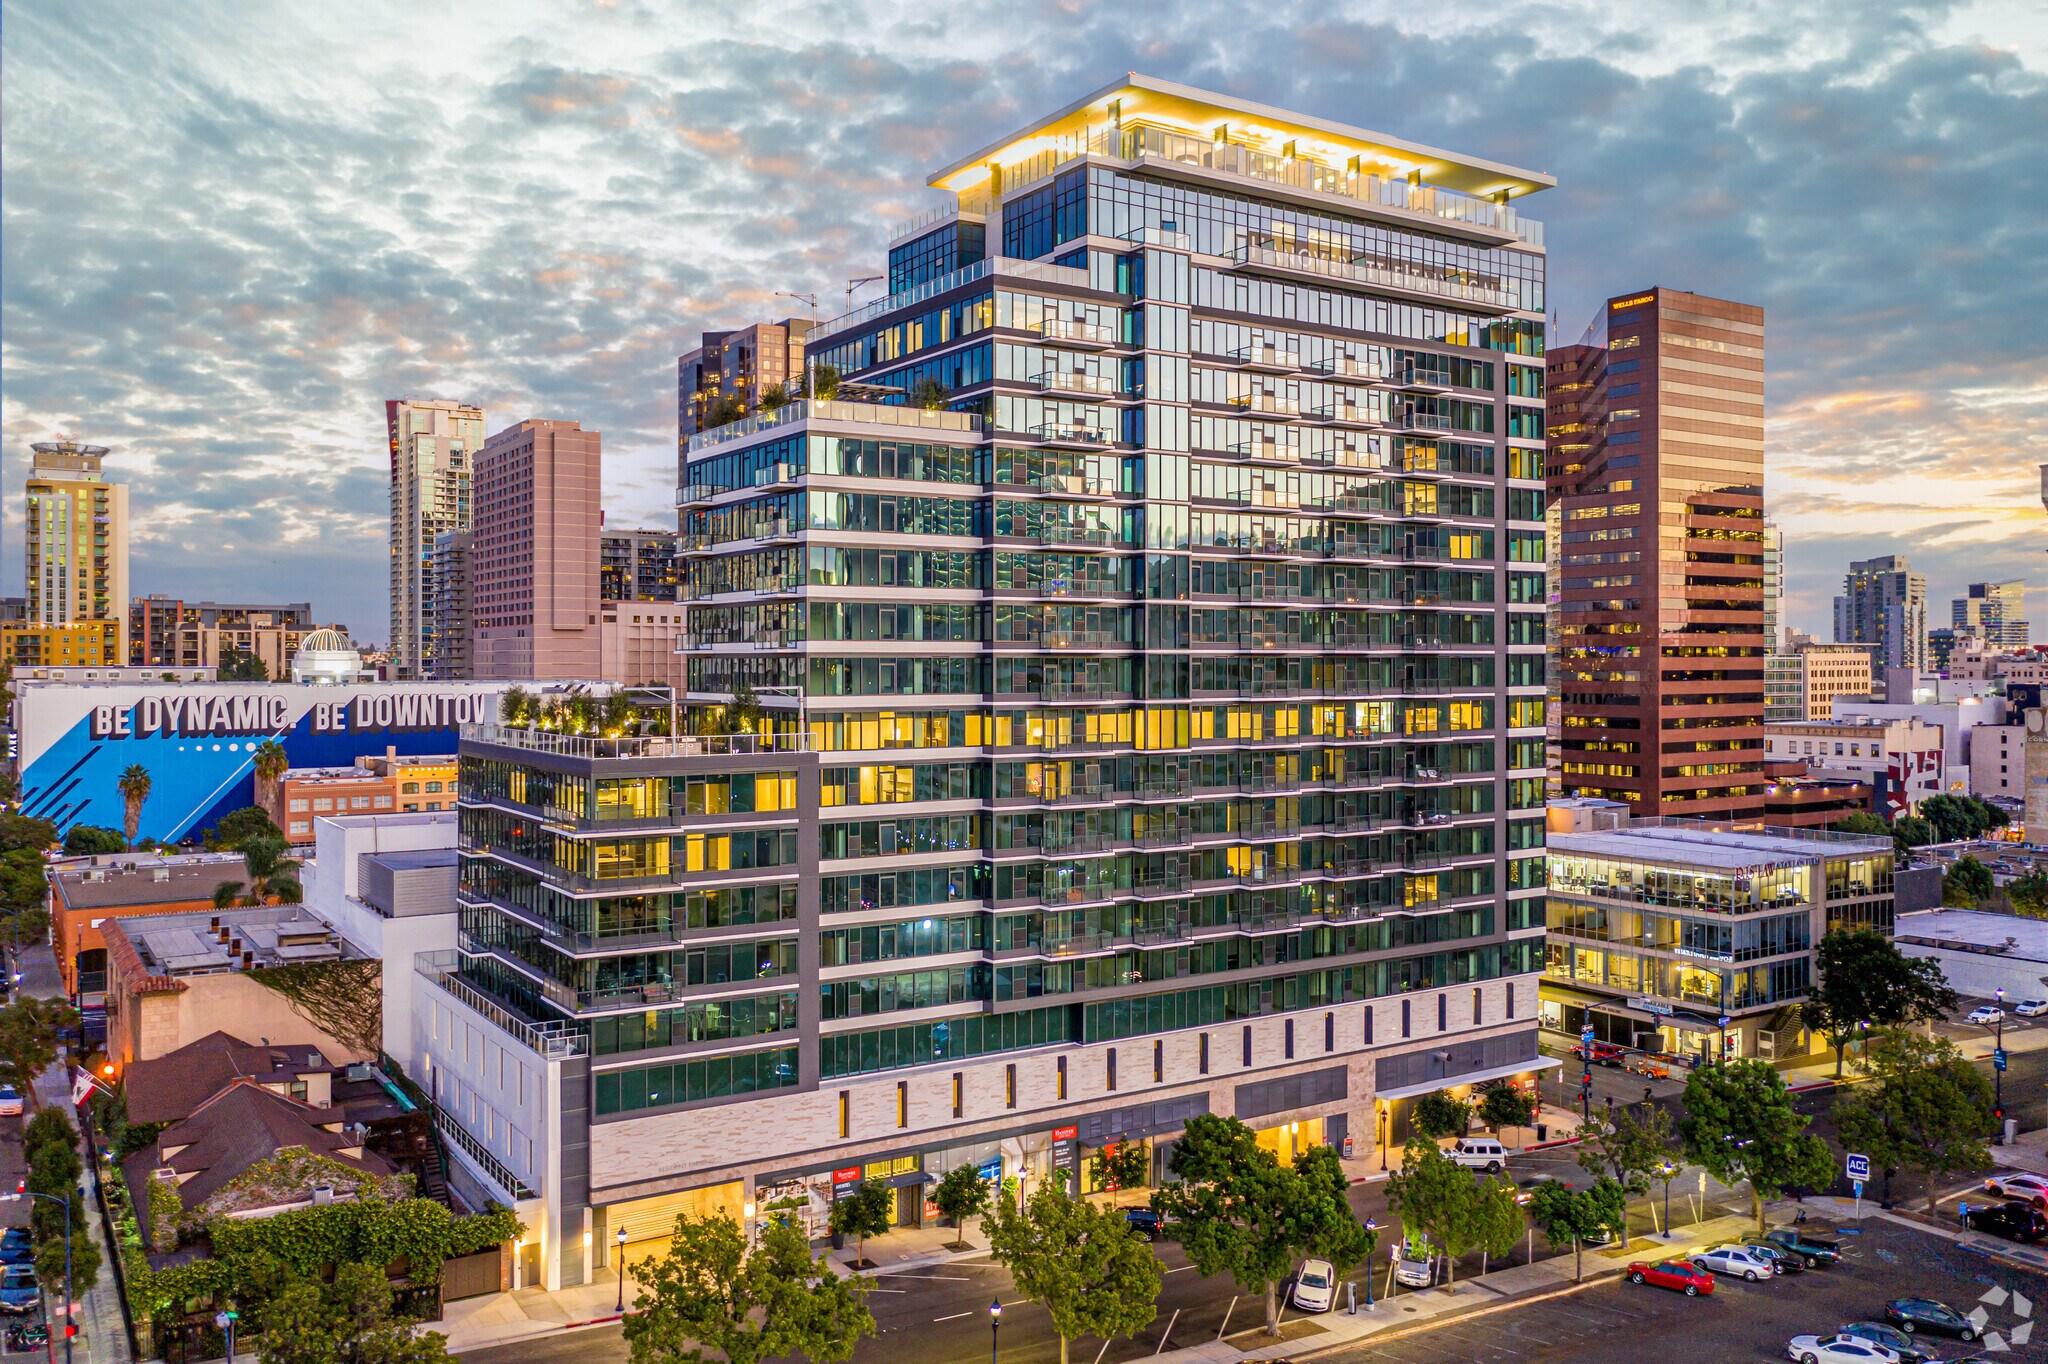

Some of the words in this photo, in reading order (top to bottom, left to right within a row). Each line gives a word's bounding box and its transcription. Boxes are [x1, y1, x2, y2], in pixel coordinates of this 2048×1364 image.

[1613, 300, 1633, 309] WELLS
[1634, 295, 1654, 305] FARGO
[97, 705, 131, 735] BE
[143, 695, 297, 731] DYNAMIC.
[316, 703, 346, 730] BE
[9, 733, 17, 758] PARK
[1757, 862, 1776, 878] LAW
[1850, 1160, 1867, 1171] ACE
